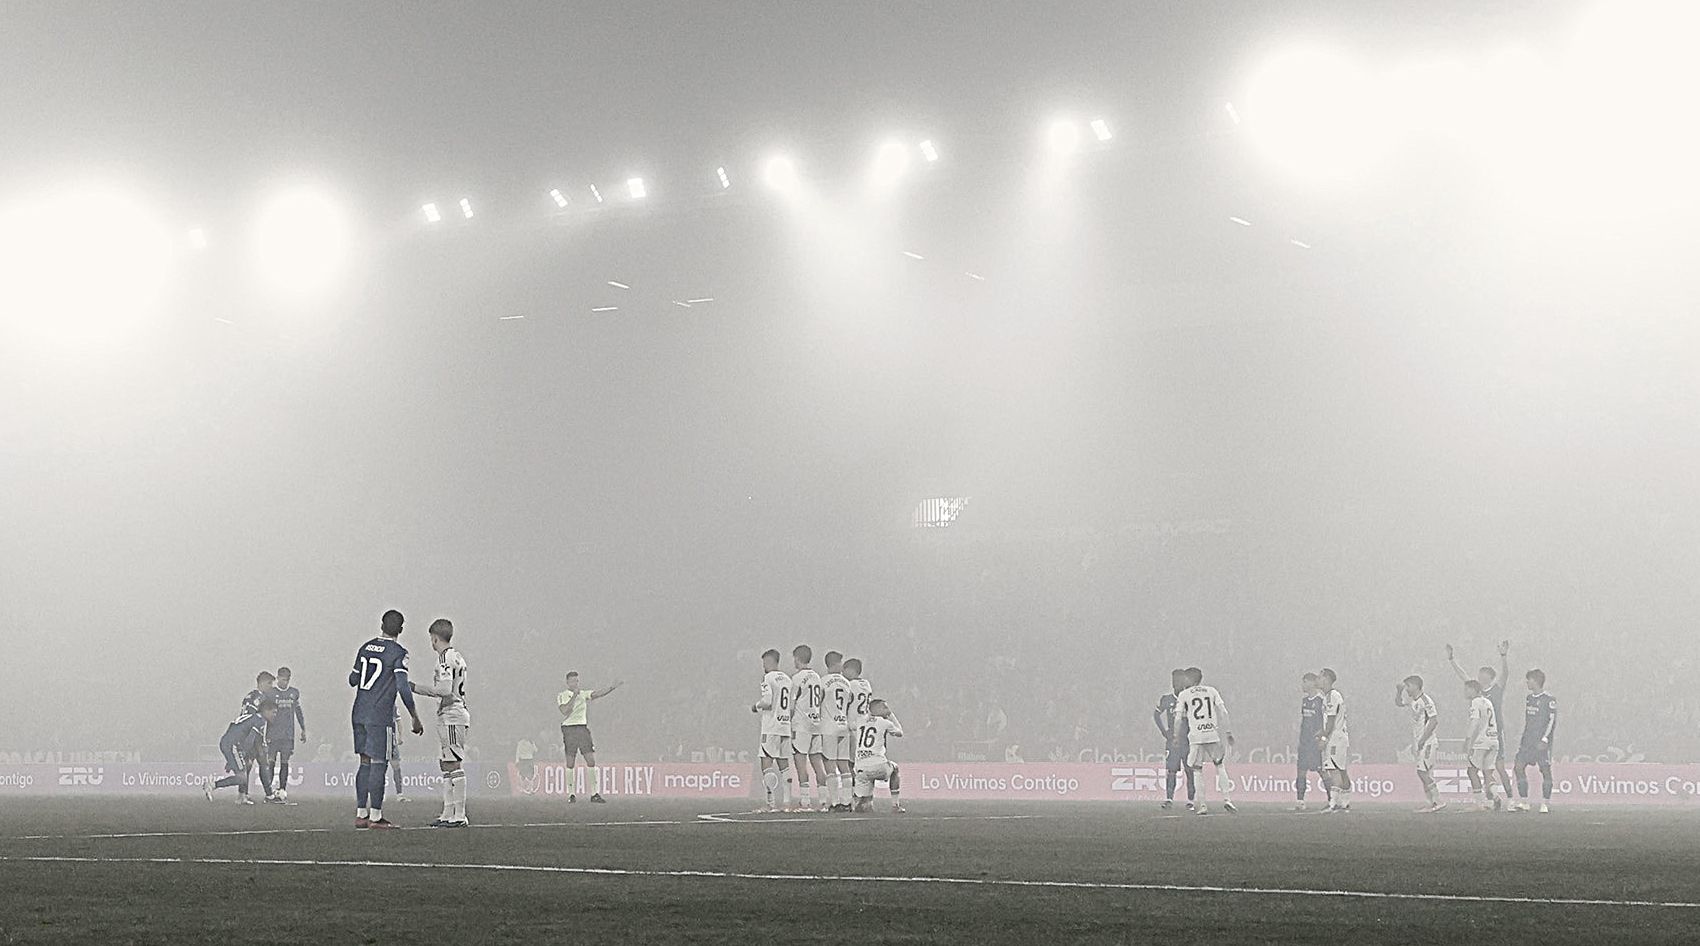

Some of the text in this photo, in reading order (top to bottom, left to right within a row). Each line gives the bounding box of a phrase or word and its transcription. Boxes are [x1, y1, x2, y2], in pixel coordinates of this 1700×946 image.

[360, 656, 383, 690] 17
[780, 686, 789, 710] 6
[808, 684, 821, 708] 18
[835, 688, 843, 711] 5
[1191, 696, 1212, 720] 21
[858, 725, 877, 748] 16
[1078, 746, 1165, 763] Globalca
[0, 771, 33, 789] ontigo
[58, 767, 104, 785] ZRU
[122, 771, 226, 786] Lo Vivimos Conti
[324, 773, 338, 786] Lo
[544, 766, 586, 794] COA
[624, 766, 654, 795] REY
[664, 771, 741, 791] mapfre
[921, 773, 1079, 794] Lo Vivimos Contigo
[1316, 776, 1394, 797] Cntigo
[1577, 775, 1660, 794] Vivimos
